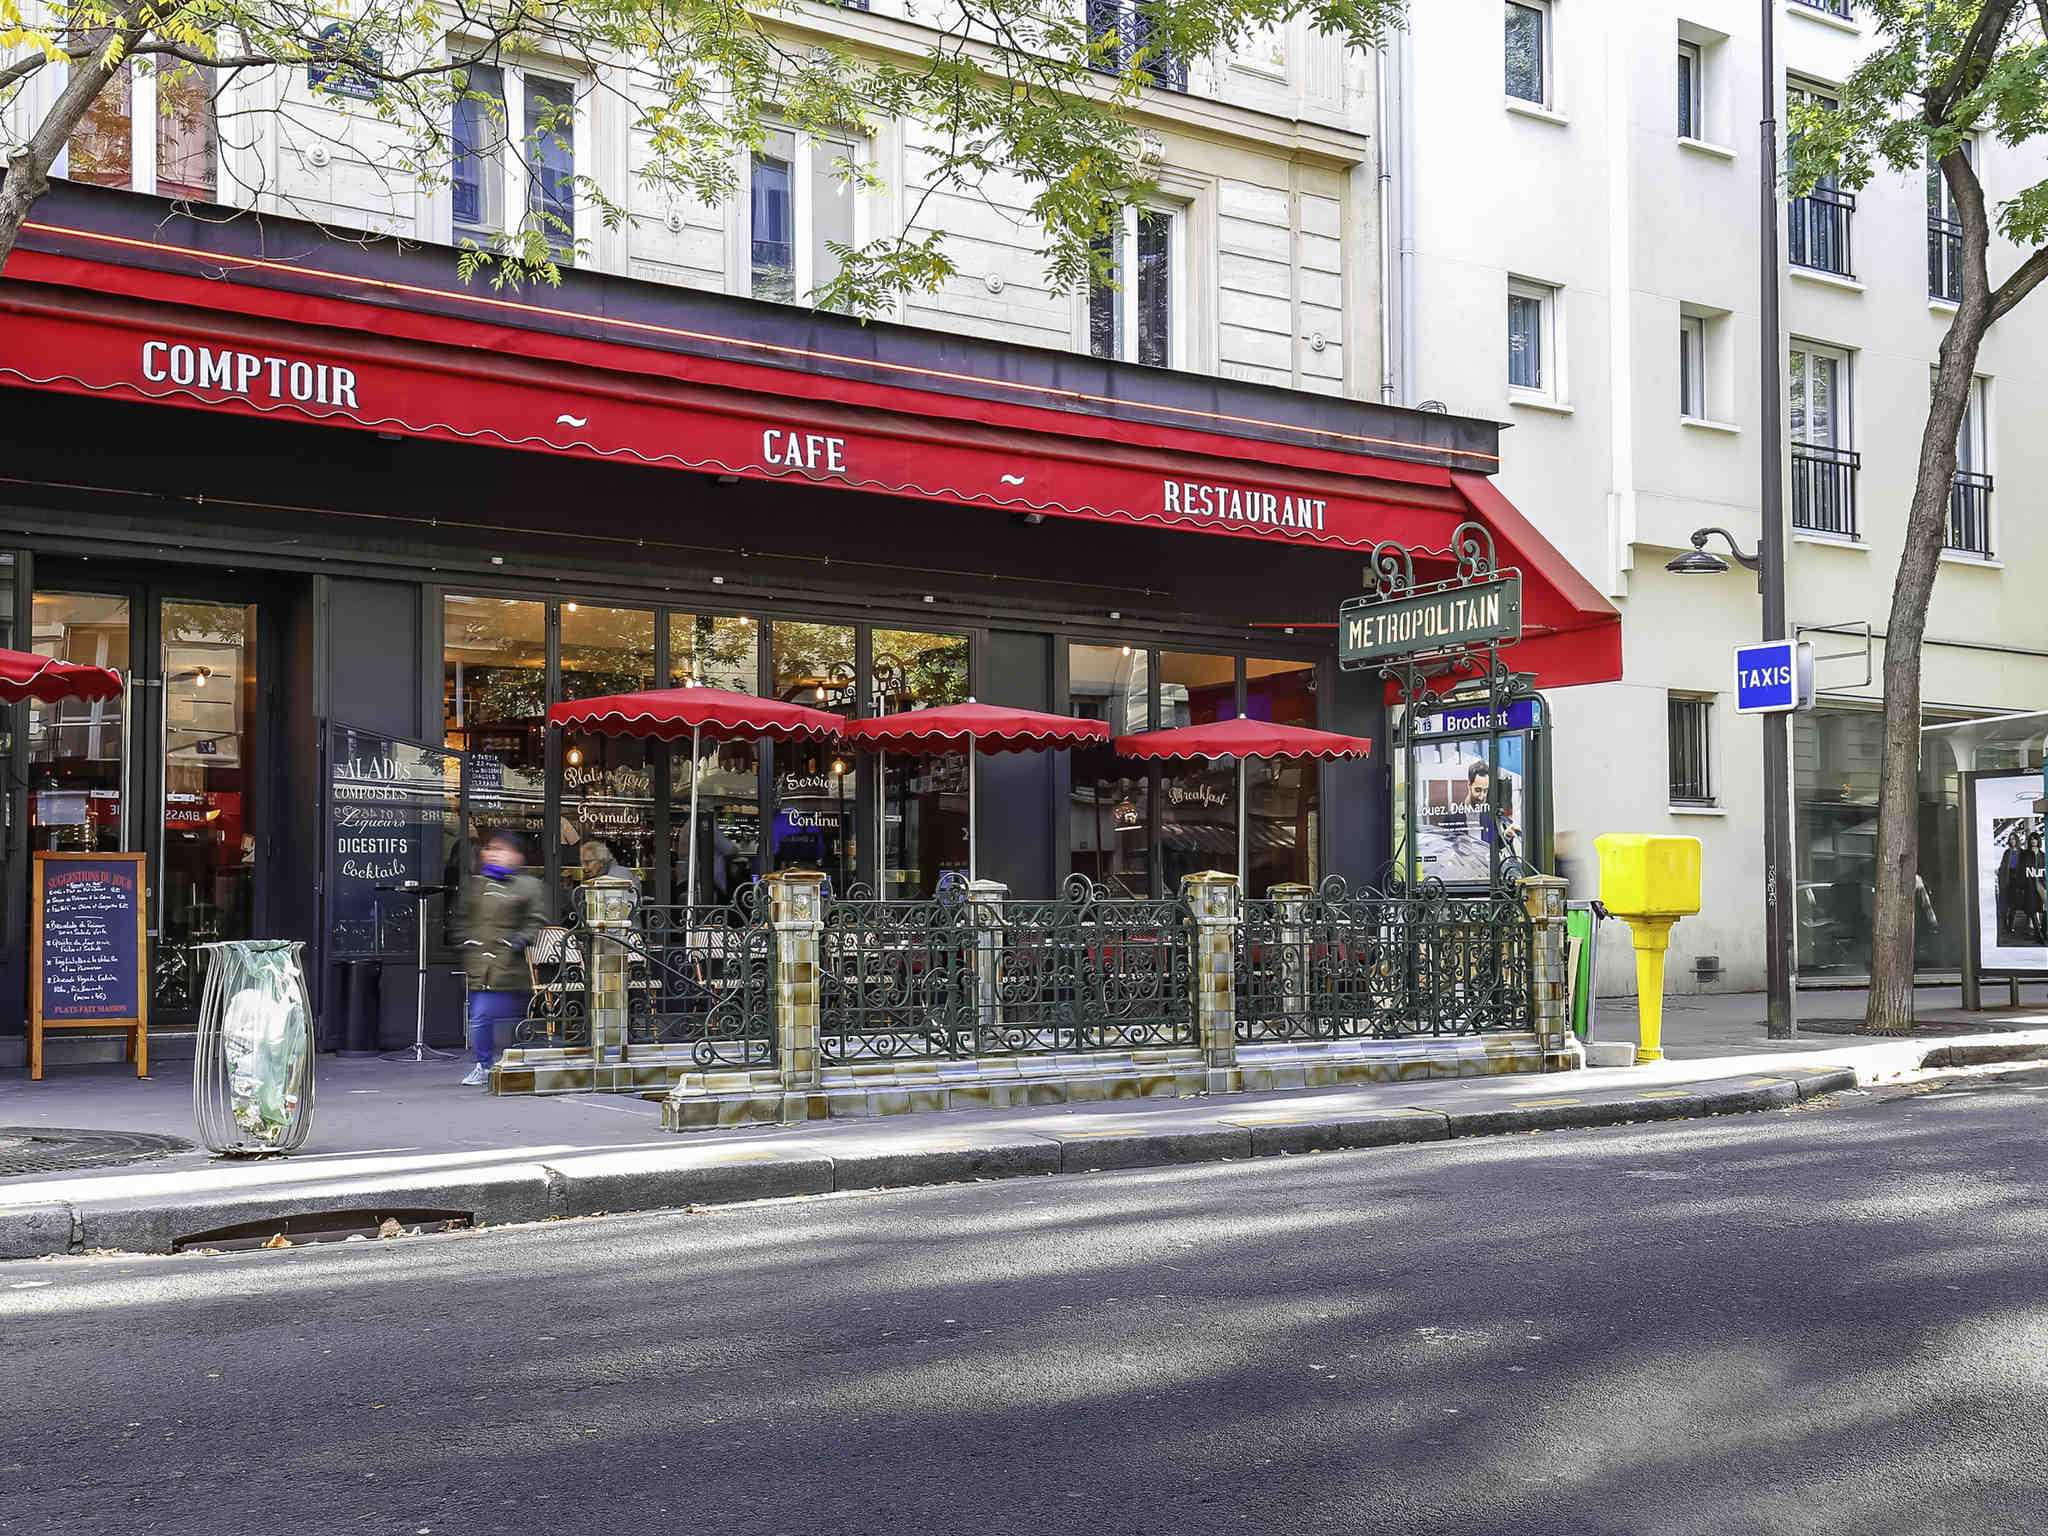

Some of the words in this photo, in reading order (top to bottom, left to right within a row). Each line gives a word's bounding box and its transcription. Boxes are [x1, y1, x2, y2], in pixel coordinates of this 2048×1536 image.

[142, 341, 359, 409] COMPTOIR
[763, 430, 846, 472] CAFE
[1162, 480, 1326, 530] RESTAURANT
[1349, 593, 1499, 650] METROPOLITAIN
[1739, 666, 1790, 688] TAXIS
[336, 757, 411, 780] SALADES
[564, 767, 603, 788] Plats
[1168, 784, 1228, 807] Breakfast
[337, 806, 406, 833] Liqueurs
[577, 802, 640, 823] Formules
[789, 809, 840, 827] Continu
[338, 839, 408, 853] DIGESTIFS
[342, 859, 406, 879] Cocktails
